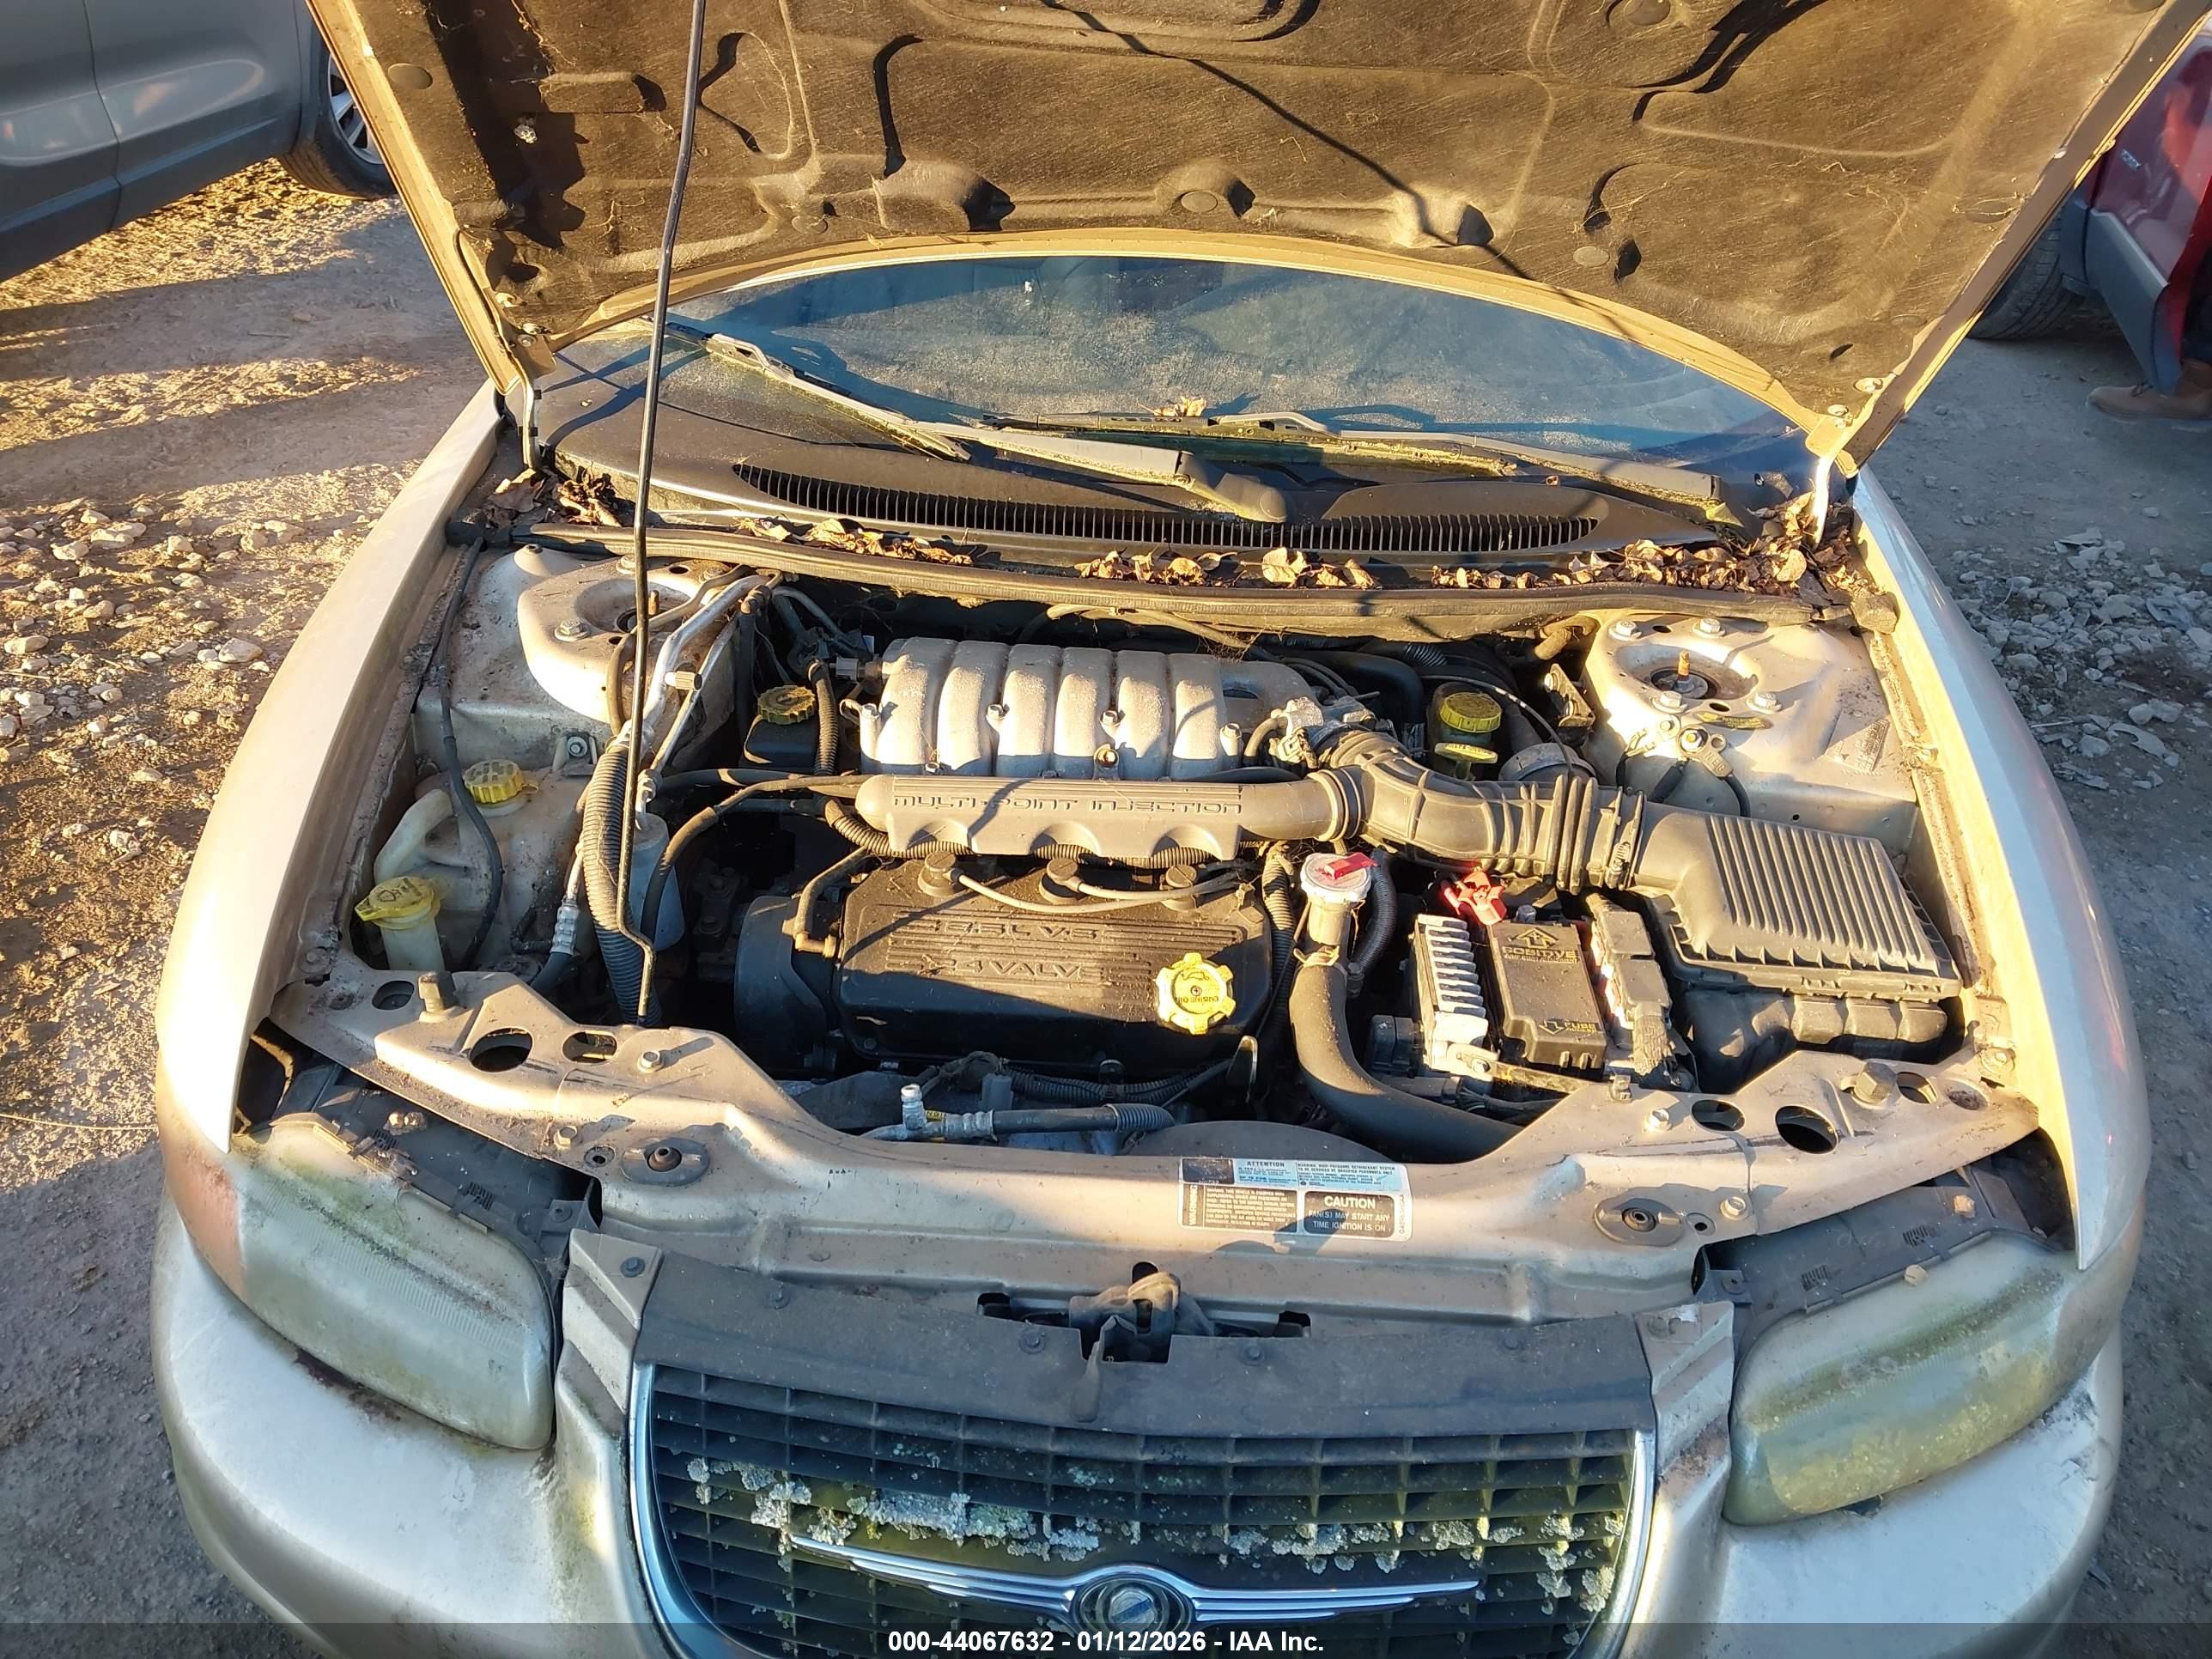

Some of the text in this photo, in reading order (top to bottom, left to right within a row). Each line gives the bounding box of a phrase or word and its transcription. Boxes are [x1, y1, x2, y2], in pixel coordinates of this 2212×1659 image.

[1091, 799, 1243, 815] INJECTION
[988, 960, 1105, 980] VALVE
[1324, 1195, 1376, 1209] CAUTION
[1308, 1209, 1391, 1223] FAN(S) MAY START ANY
[1313, 1220, 1330, 1229] TIME
[1332, 1221, 1363, 1231] IGNITION
